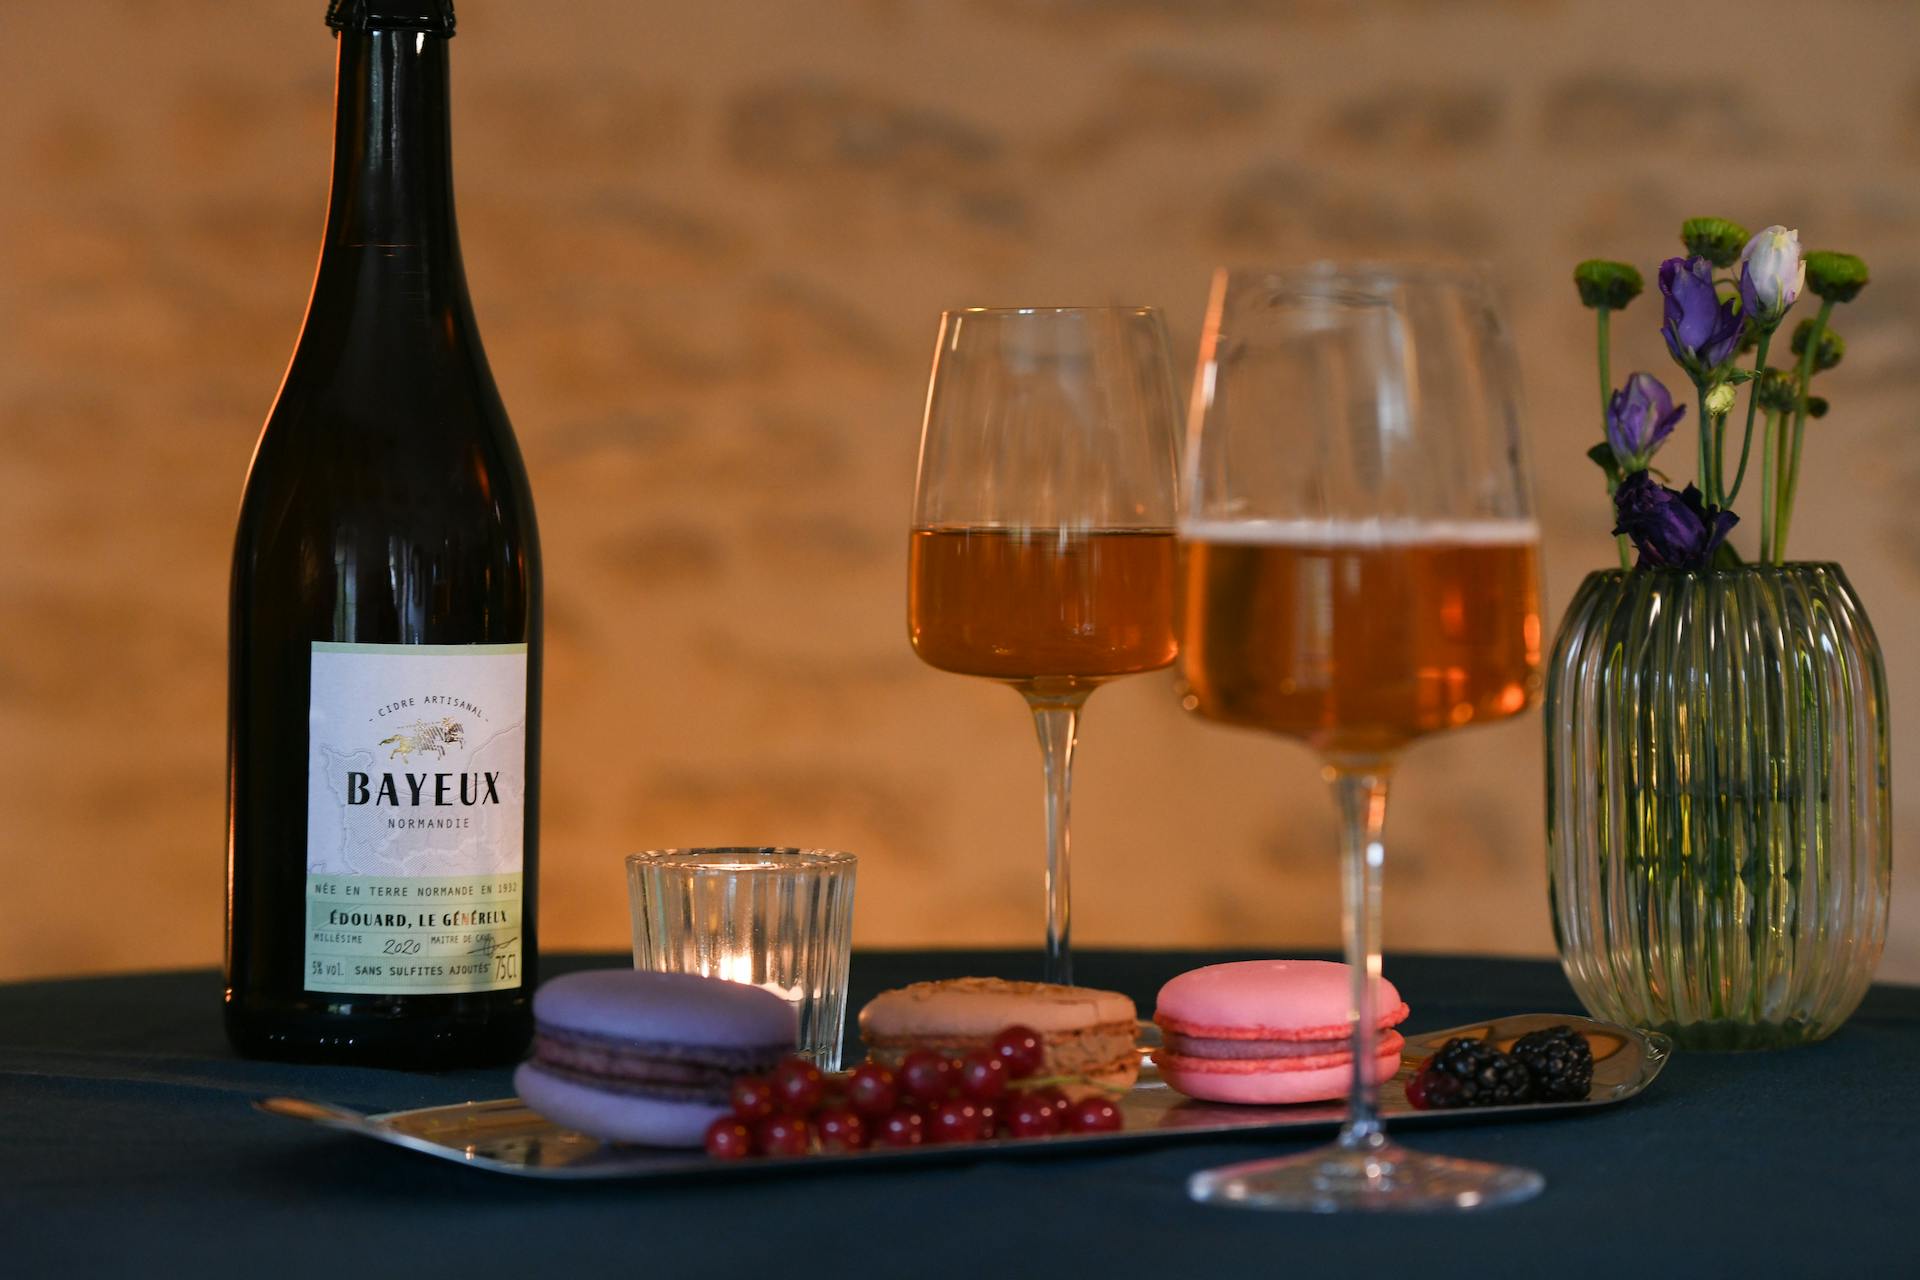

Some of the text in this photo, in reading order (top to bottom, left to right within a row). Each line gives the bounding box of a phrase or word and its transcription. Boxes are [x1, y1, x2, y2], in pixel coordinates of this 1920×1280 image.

[377, 695, 482, 718] CIDRE ARTISANAL
[347, 771, 500, 806] BAYEUX
[388, 818, 470, 829] NORMANDIE
[314, 882, 337, 895] NÉE
[345, 885, 360, 896] EN
[369, 886, 408, 897] TERRE
[417, 886, 474, 897] NORMANDE
[481, 884, 492, 895] EN
[329, 909, 507, 929] ÉDOUARD, LE GÉNÉREUX
[313, 932, 363, 944] MILLÉSIME
[463, 934, 472, 944] DE
[382, 939, 421, 955] 2020
[354, 963, 490, 977] SANS SULFITES AJOUTÉS
